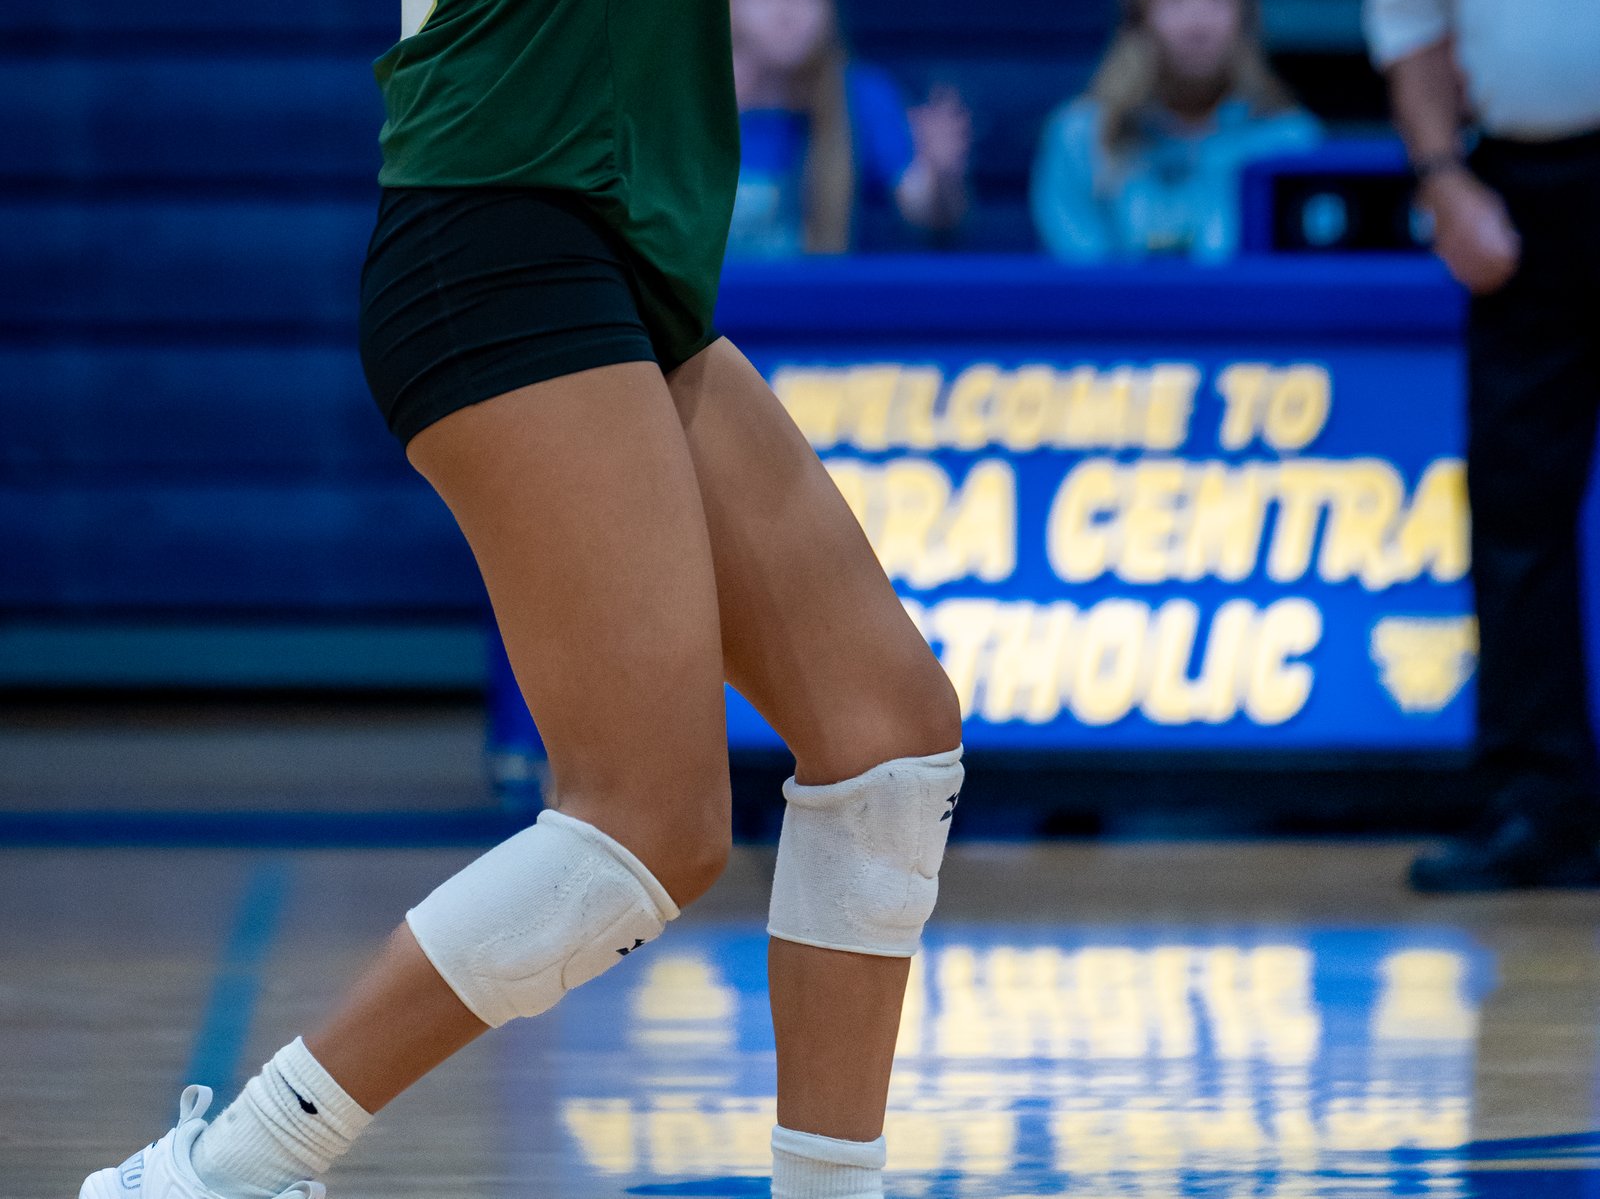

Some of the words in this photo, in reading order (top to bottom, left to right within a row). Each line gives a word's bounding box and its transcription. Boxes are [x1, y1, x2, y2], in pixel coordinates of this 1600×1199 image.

[771, 362, 1200, 451] WELCOME
[1217, 362, 1331, 452] TO
[900, 597, 1324, 725] THOLIC
